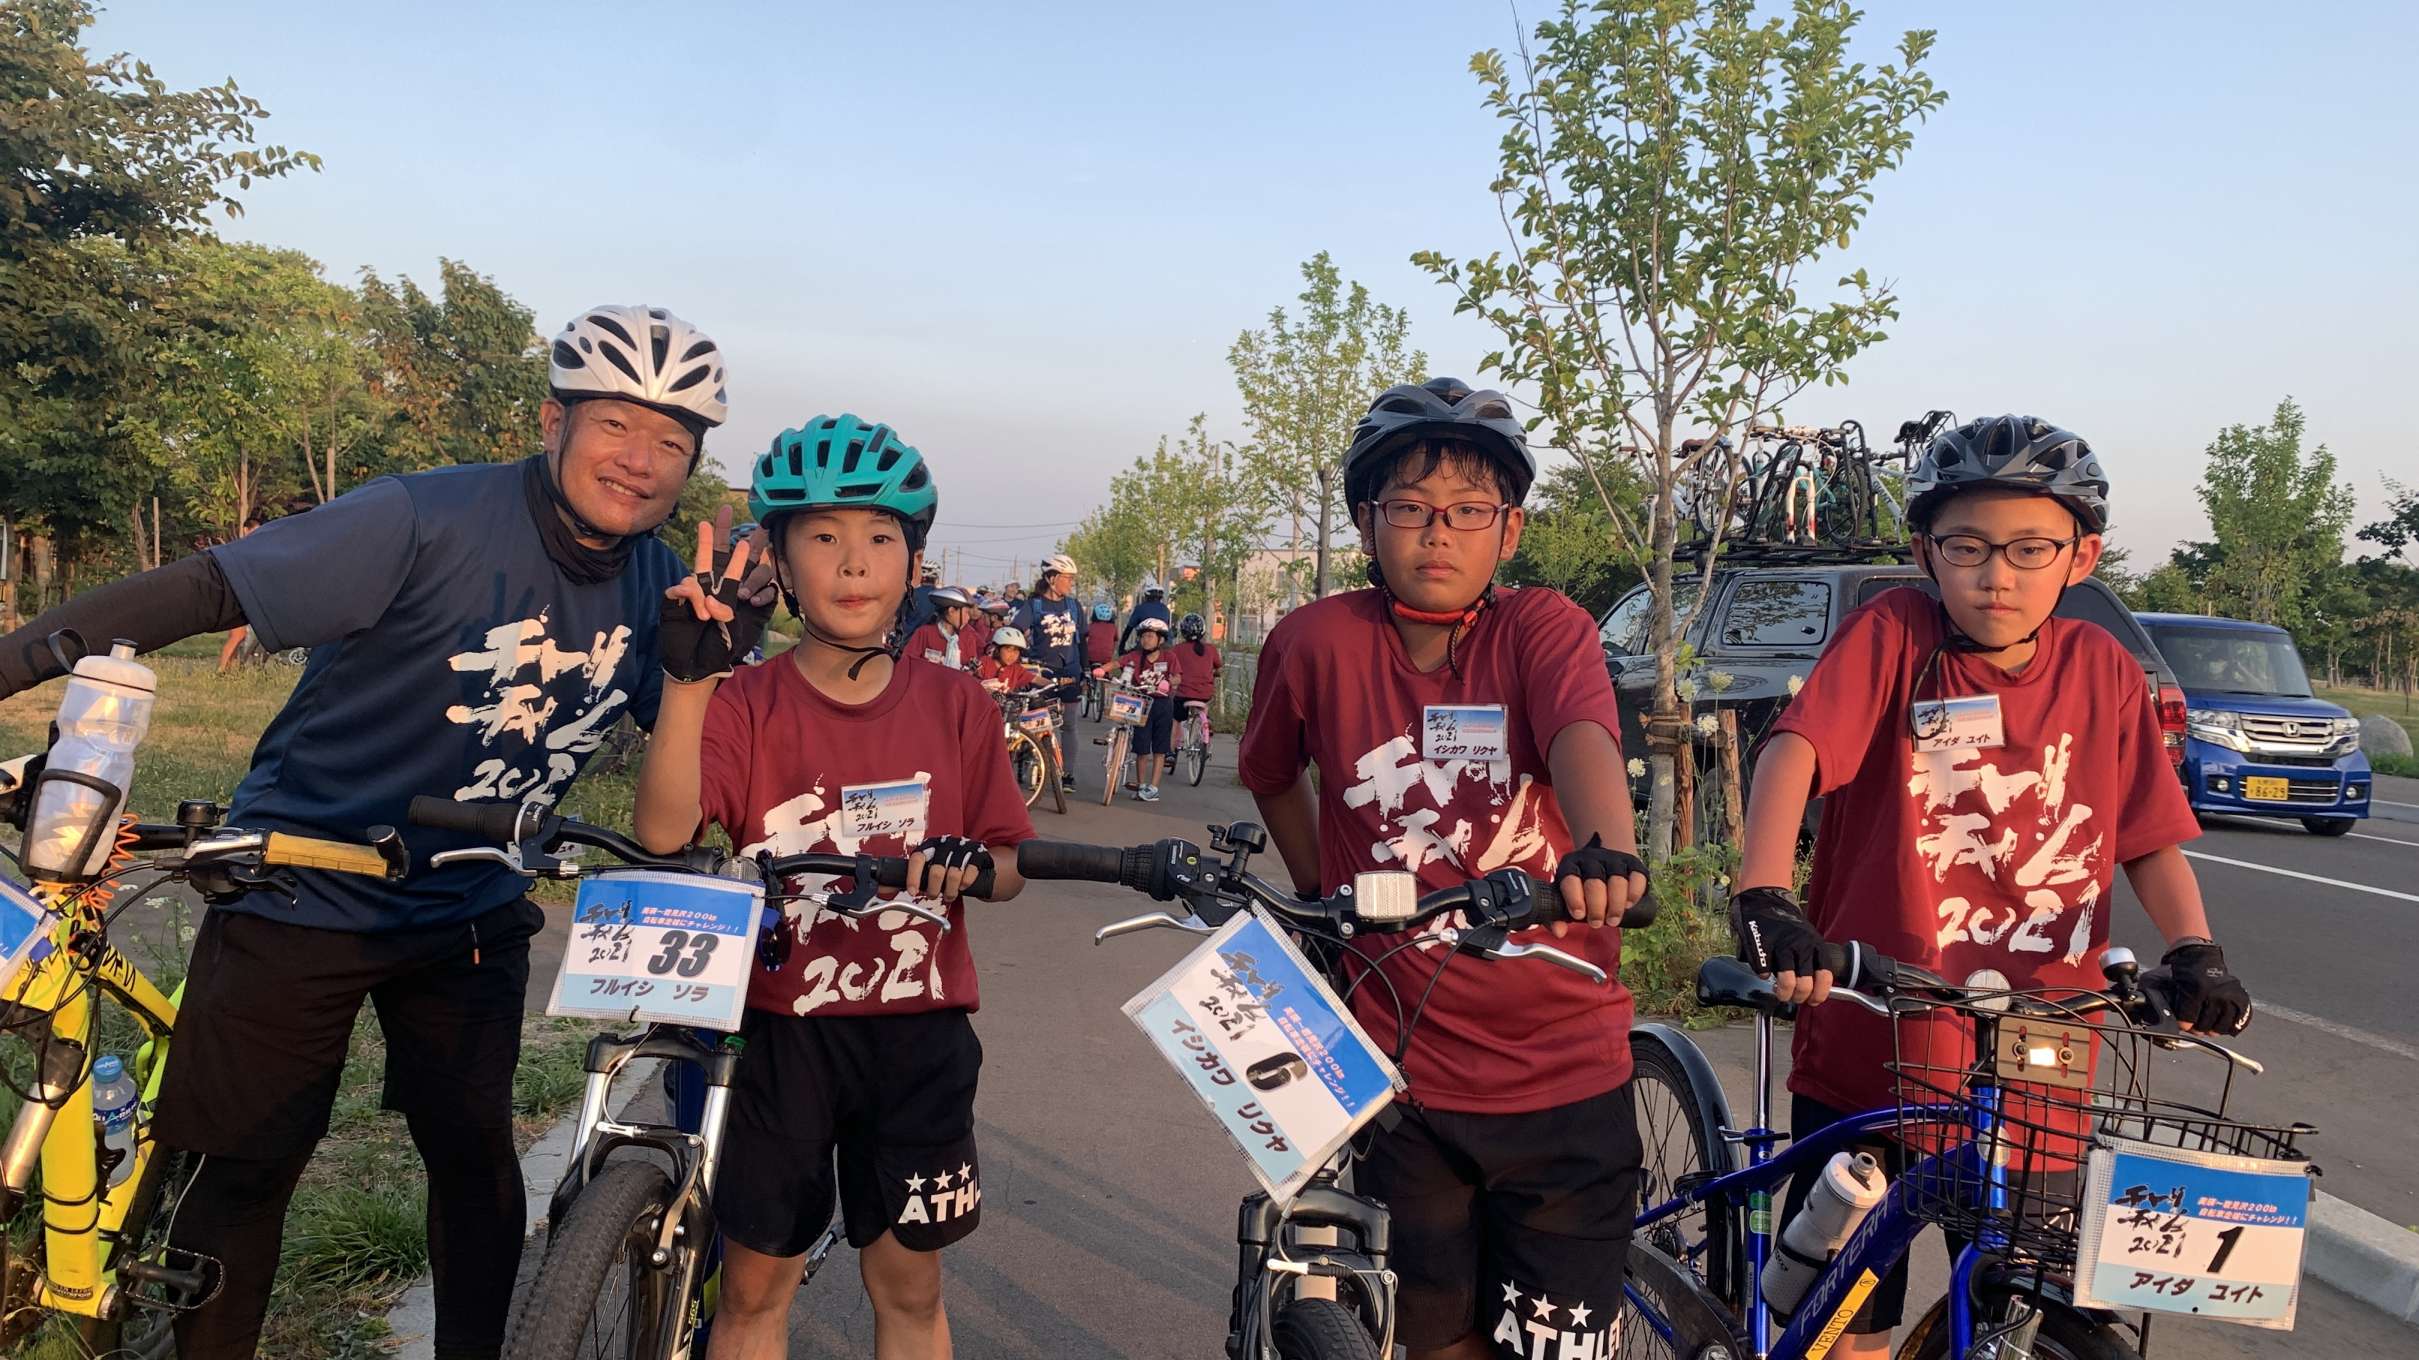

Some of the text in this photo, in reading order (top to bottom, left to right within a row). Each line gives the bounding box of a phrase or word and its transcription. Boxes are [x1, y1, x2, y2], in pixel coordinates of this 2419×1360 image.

[1434, 745, 1498, 755] イシカワ リクヤ
[1933, 734, 1991, 747] アイダ ユイト
[857, 817, 914, 832] フルイシ ソラ
[1748, 920, 1767, 967] Kabuto
[1936, 879, 2100, 967] 2021
[589, 940, 632, 963] 2021
[648, 930, 720, 977] 33
[793, 930, 945, 1017] 2021
[590, 978, 710, 1002] フルイシ ソラ
[1199, 996, 1256, 1040] 2021
[1171, 1018, 1288, 1153] イシカワ リクヤ
[1246, 1052, 1308, 1091] 6
[2128, 1233, 2186, 1258] 2021
[2206, 1225, 2244, 1274] 1
[1800, 1199, 1889, 1337] FORTERA
[2130, 1272, 2264, 1303] アイダ ユイト
[1811, 1308, 1854, 1352] VENTO
